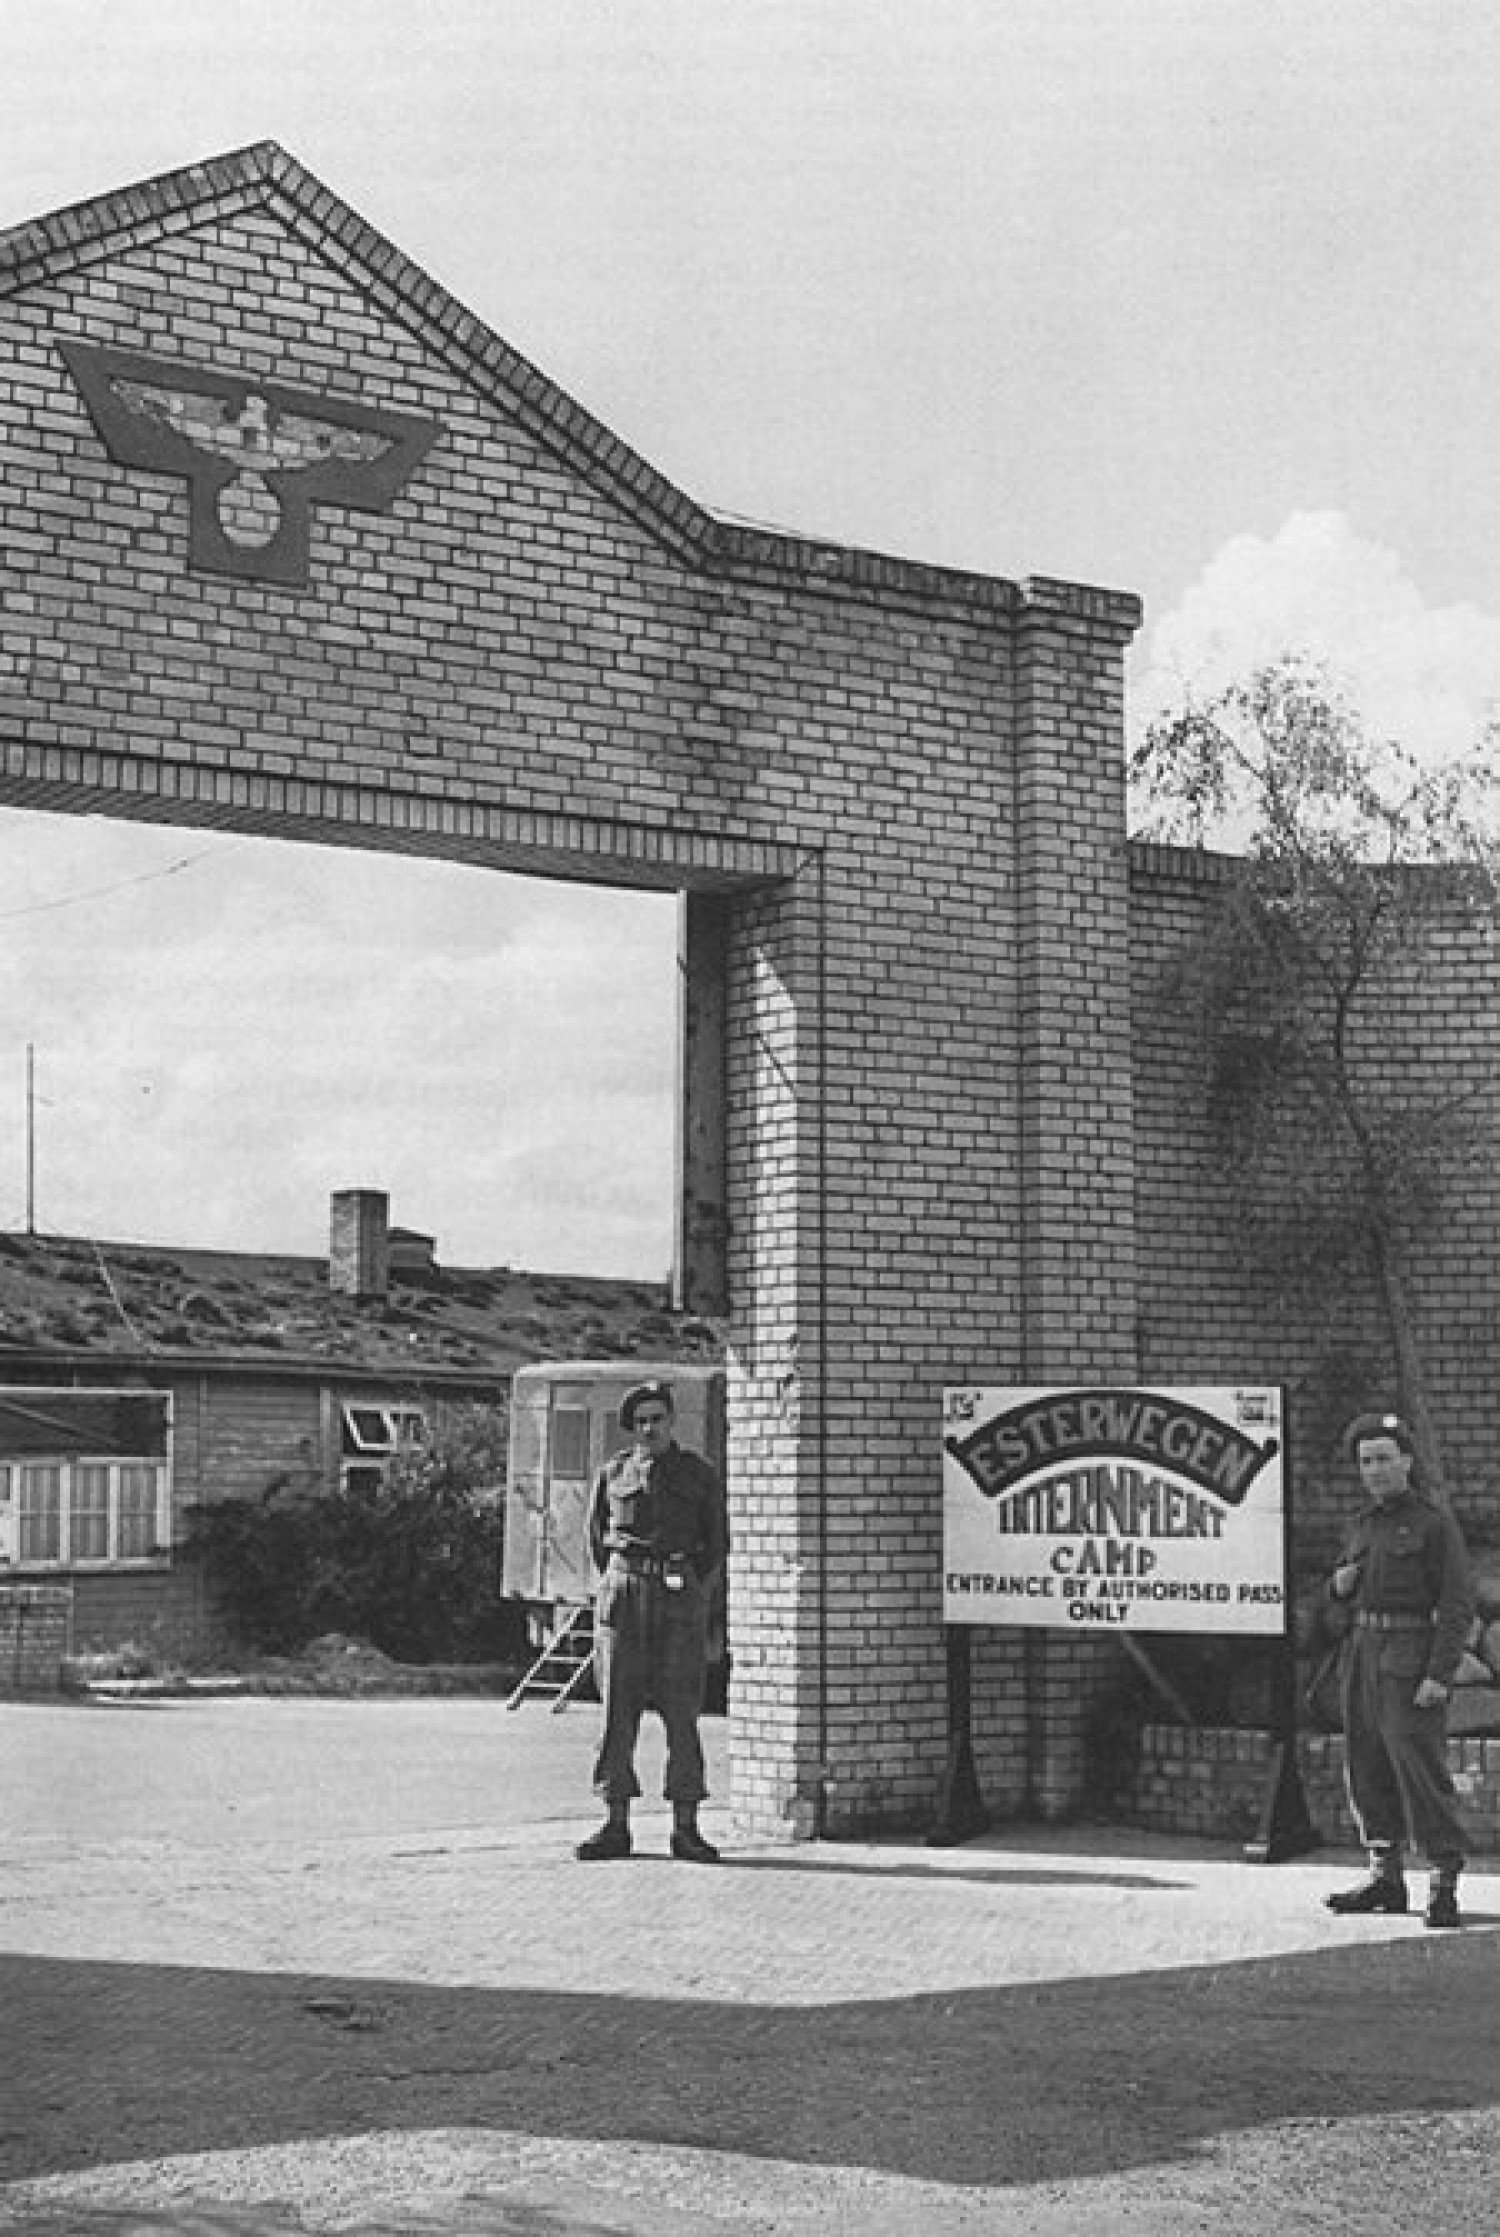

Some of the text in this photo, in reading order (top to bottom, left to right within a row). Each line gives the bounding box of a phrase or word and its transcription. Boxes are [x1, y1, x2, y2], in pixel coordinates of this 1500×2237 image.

[967, 1398, 1254, 1488] ESTERWEGEN
[999, 1466, 1227, 1538] INTERNMENT
[1050, 1539, 1157, 1576] CAMP
[947, 1573, 1281, 1605] ENTRANCE BY AUTHORISED PASS
[1068, 1601, 1130, 1622] ONLY
